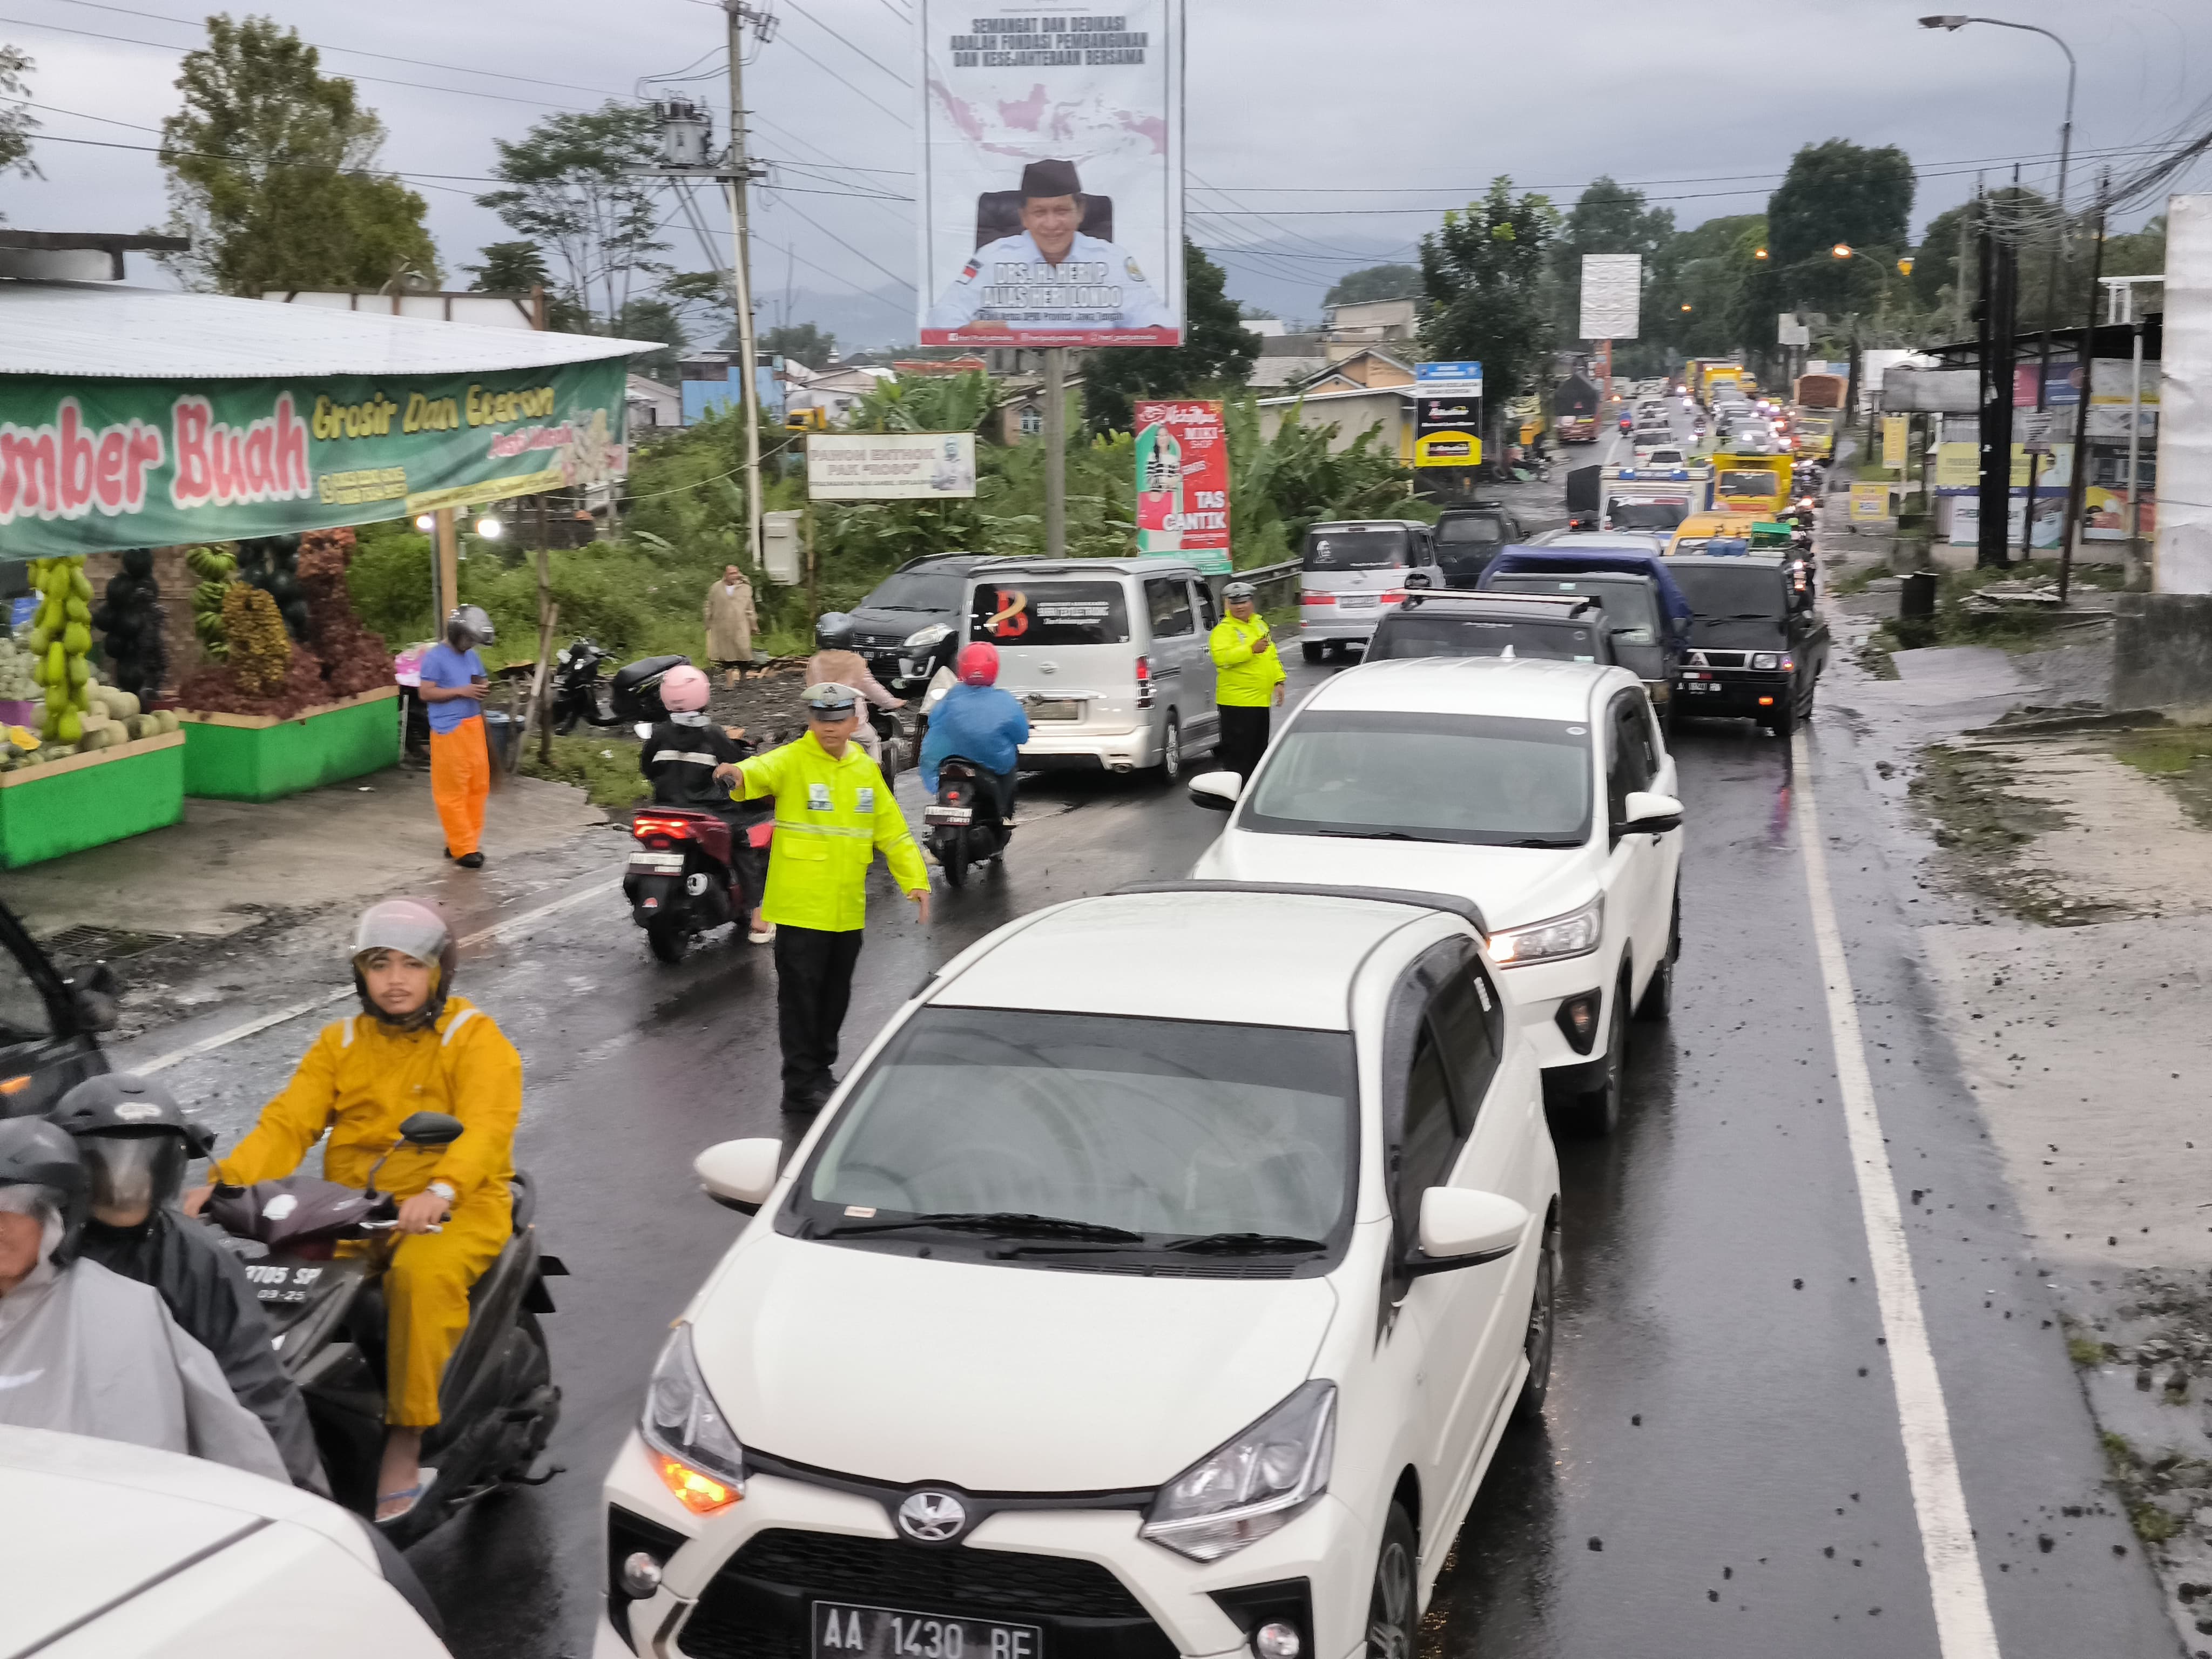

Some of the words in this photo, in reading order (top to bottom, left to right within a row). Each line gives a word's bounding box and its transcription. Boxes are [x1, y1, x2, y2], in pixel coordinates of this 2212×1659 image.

[972, 18, 1038, 33] SEMANGAT
[1041, 17, 1067, 32] DAN
[953, 51, 979, 66] DAN
[1085, 49, 1145, 65] BERSAMA
[312, 392, 398, 440] Grosir
[403, 391, 460, 434] Dan
[172, 393, 310, 507] Buah
[1195, 491, 1225, 508] TAS
[1163, 512, 1227, 531] CANTIK
[824, 1608, 863, 1650] AA
[890, 1617, 963, 1659] 1430
